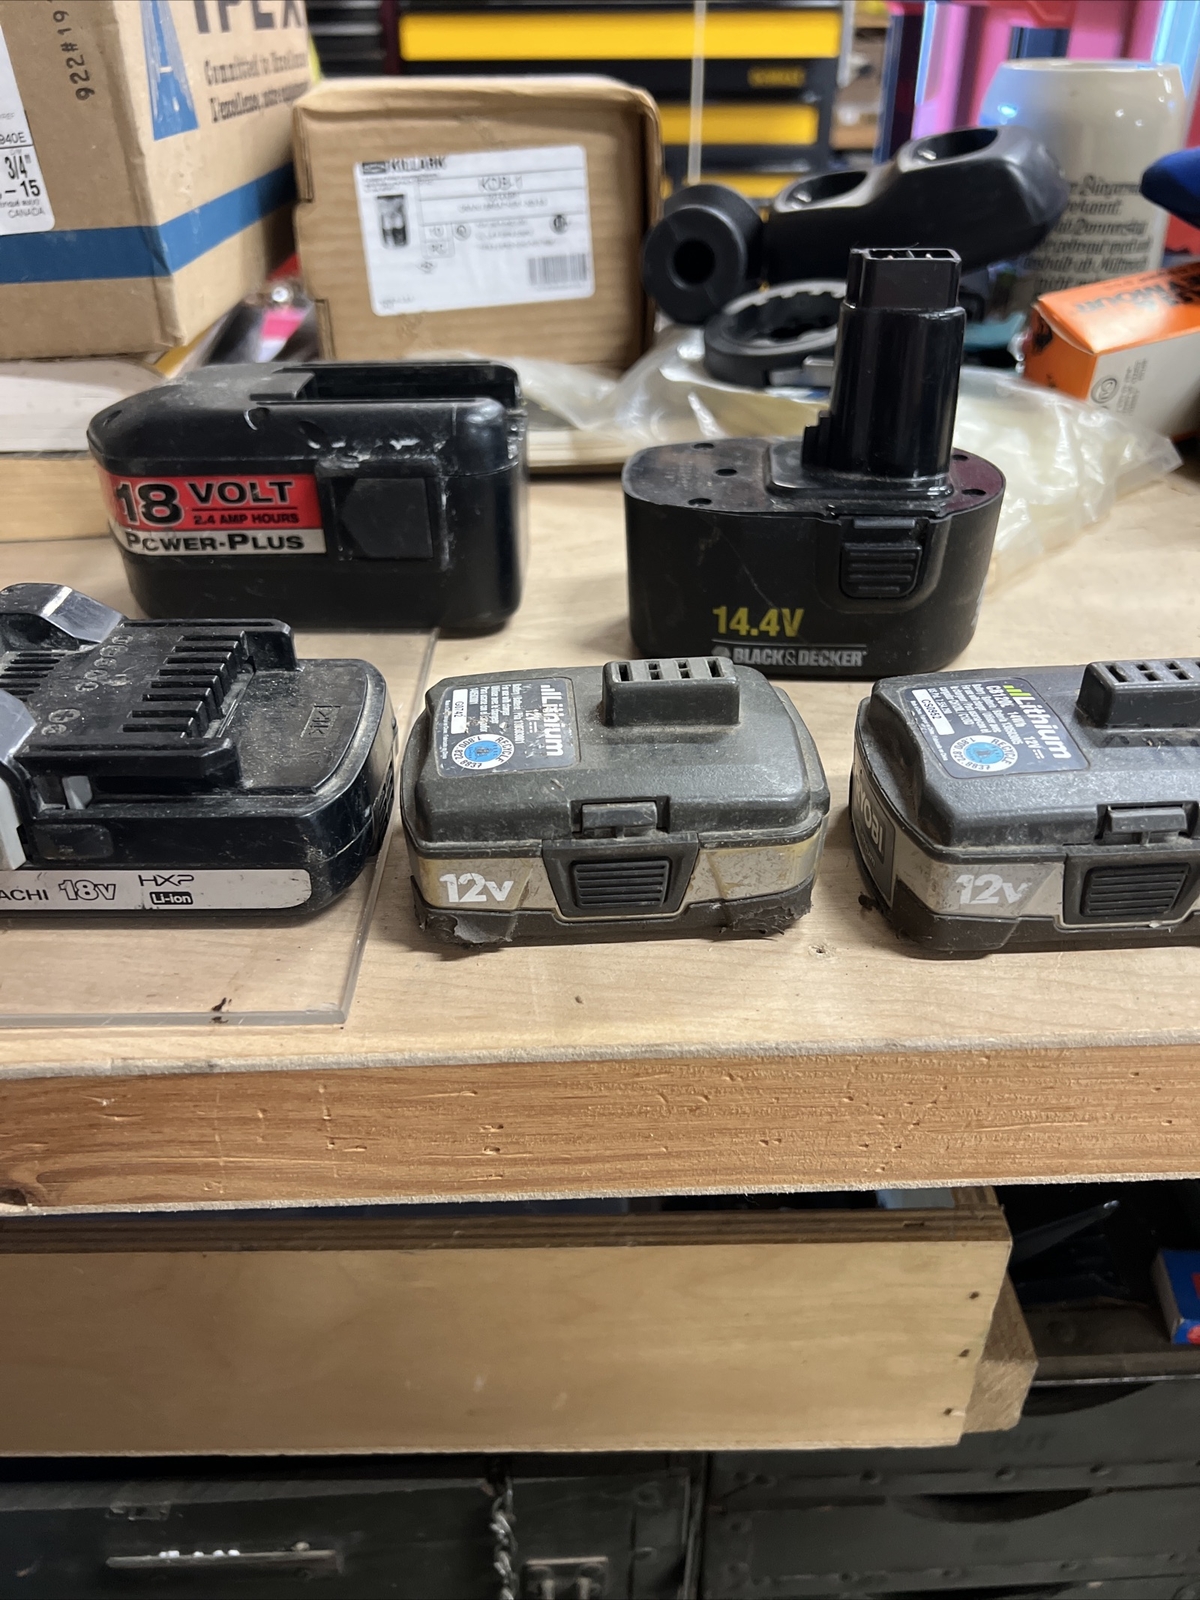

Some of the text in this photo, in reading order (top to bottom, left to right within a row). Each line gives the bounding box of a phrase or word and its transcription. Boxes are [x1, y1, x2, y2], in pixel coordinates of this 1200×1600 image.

[116, 480, 294, 526] 18 VOLT
[193, 513, 299, 525] 2.4 AMP HOURS
[712, 605, 804, 637] 14.4V
[1012, 696, 1072, 759] Lithium
